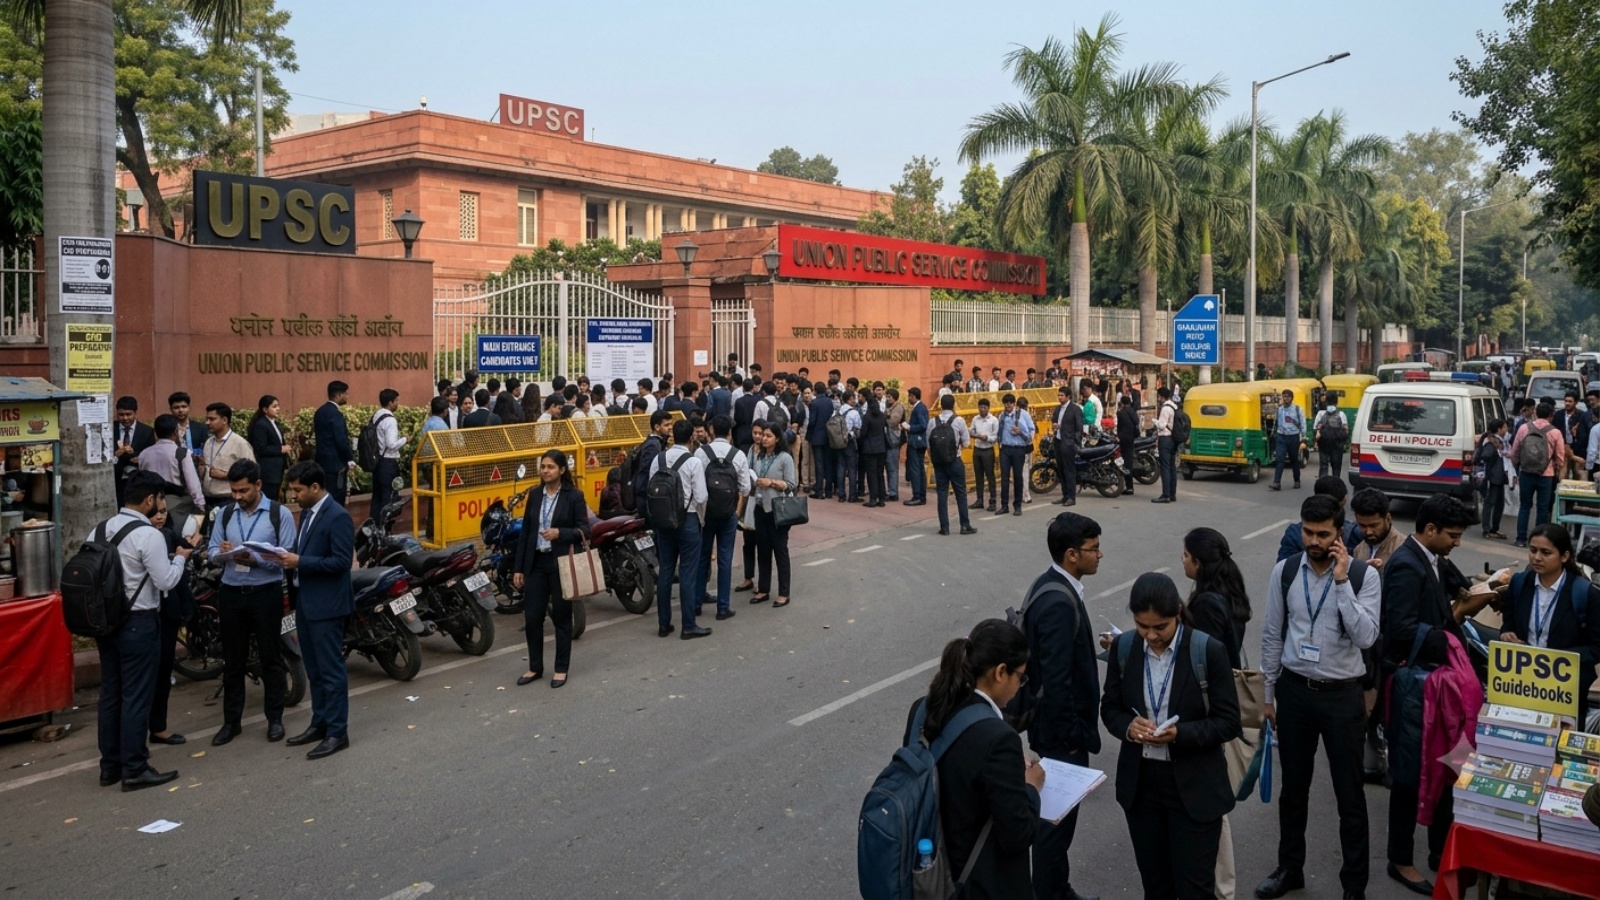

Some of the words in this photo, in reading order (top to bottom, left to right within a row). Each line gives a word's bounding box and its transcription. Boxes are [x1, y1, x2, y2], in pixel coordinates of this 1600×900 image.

[507, 99, 580, 135] UPSC
[208, 180, 350, 246] UPSC
[793, 238, 848, 270] UNION
[852, 245, 908, 275] PUBLIC
[199, 352, 243, 375] UNION
[245, 352, 294, 374] PUBLIC
[297, 352, 350, 373] SERVICE
[354, 351, 428, 372] COMMISSION
[0, 408, 20, 421] RS
[1369, 434, 1401, 443] DELHI
[1412, 436, 1453, 447] POLICE
[1495, 648, 1572, 682] UPSC
[1493, 676, 1573, 705] Guidebooks
